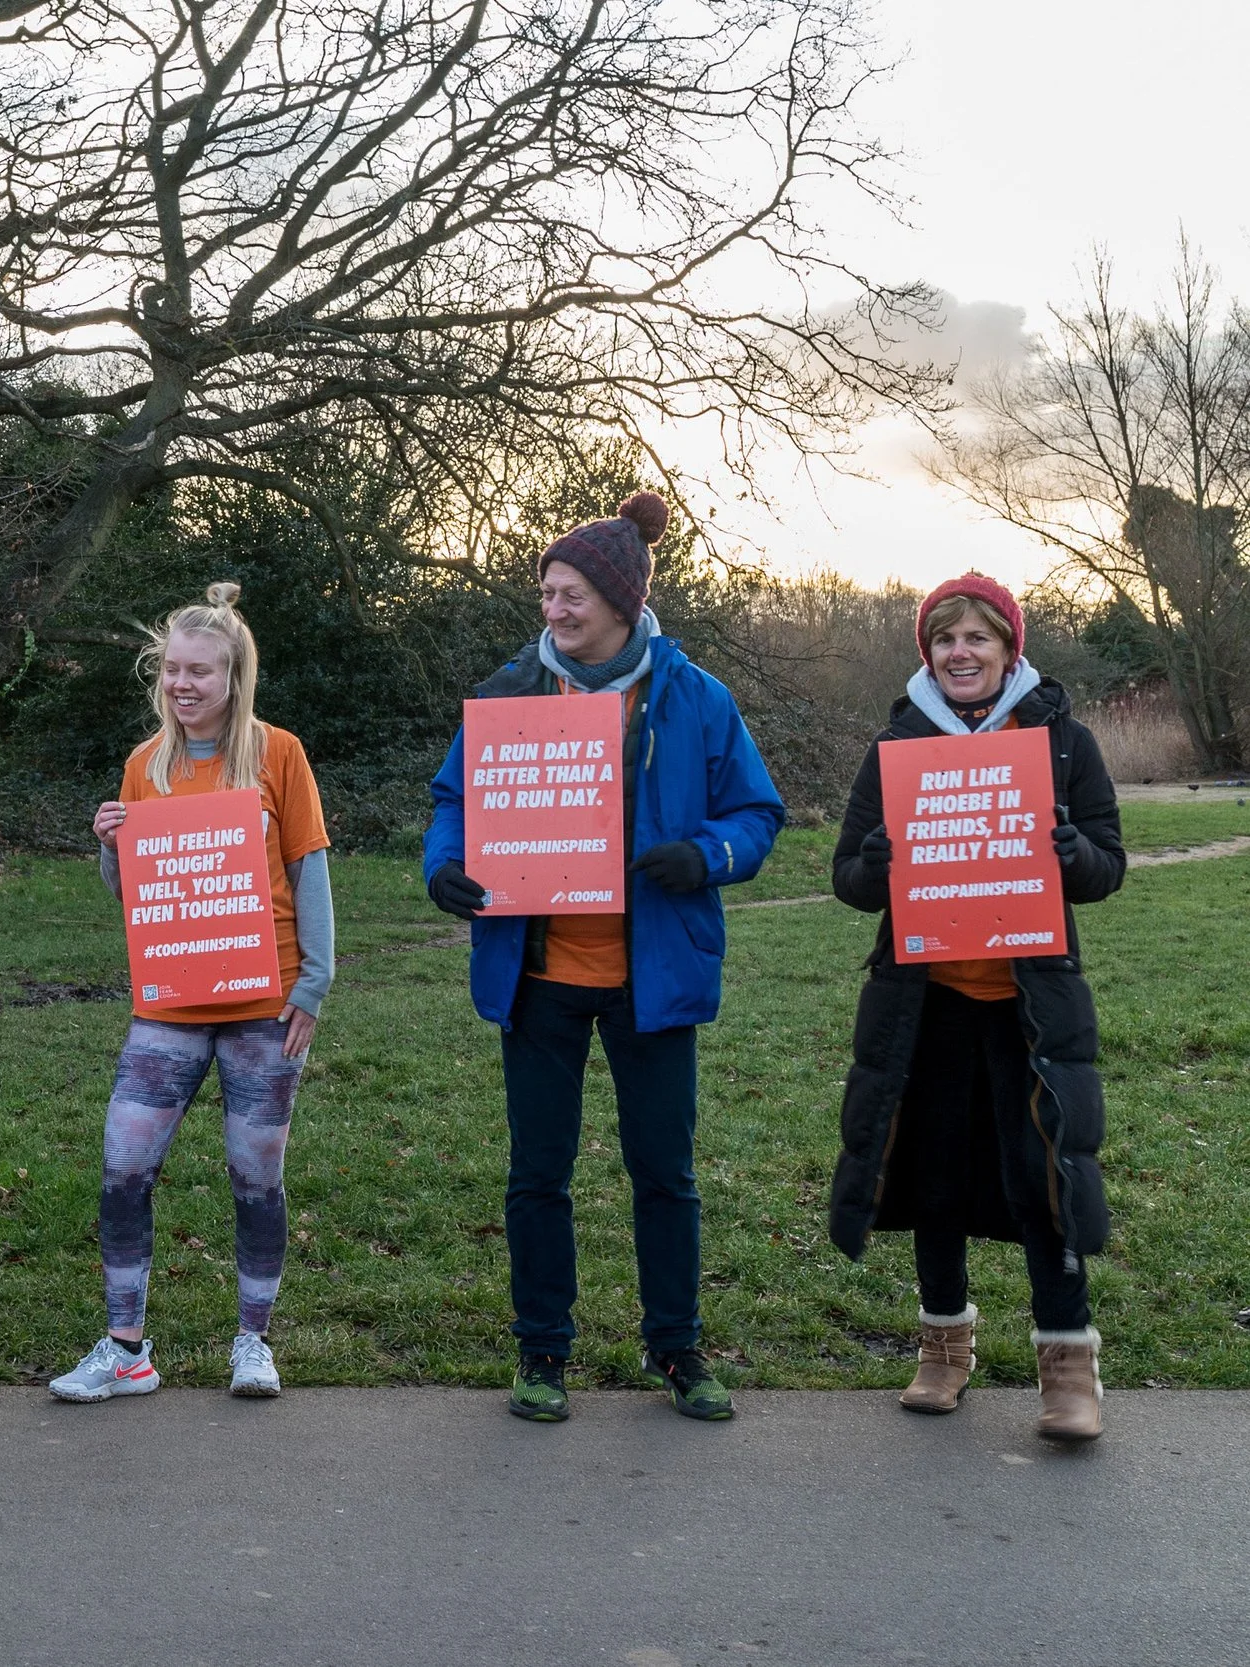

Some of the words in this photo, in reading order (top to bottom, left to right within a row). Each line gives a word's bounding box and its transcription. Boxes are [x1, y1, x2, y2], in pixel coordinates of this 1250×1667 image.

[481, 745, 493, 762] A
[499, 743, 538, 762] RUN
[543, 741, 582, 760] DAY
[586, 740, 604, 758] IS
[473, 767, 540, 786] BETTER
[546, 765, 595, 784] THAN
[599, 764, 613, 782] A
[921, 770, 963, 791] RUN
[969, 766, 1012, 787] LIKE
[483, 791, 510, 810] NO
[515, 790, 555, 809] RUN
[560, 788, 603, 806] DAY.
[915, 792, 993, 816] PHOEBE
[998, 790, 1021, 808] IN
[906, 817, 992, 841] FRIENDS,
[999, 813, 1035, 834] IT'S
[136, 836, 173, 856] RUN
[178, 827, 245, 851] FEELING
[481, 839, 607, 855] #COOPAHINSPIRES
[911, 841, 983, 865] REALLY
[987, 838, 1033, 859] FUN.
[155, 851, 226, 877] TOUGH?
[138, 882, 186, 901] WELL,
[192, 872, 253, 895] YOU'RE
[568, 891, 613, 902] COOPAH
[908, 878, 1044, 901] #COOPAHINSPIRES
[131, 905, 174, 925] EVEN
[179, 895, 265, 920] TOUGHER.
[143, 934, 261, 958] #COOPAHINSPIRES
[1004, 931, 1054, 946] COOPAH
[228, 976, 269, 990] COOPAH
